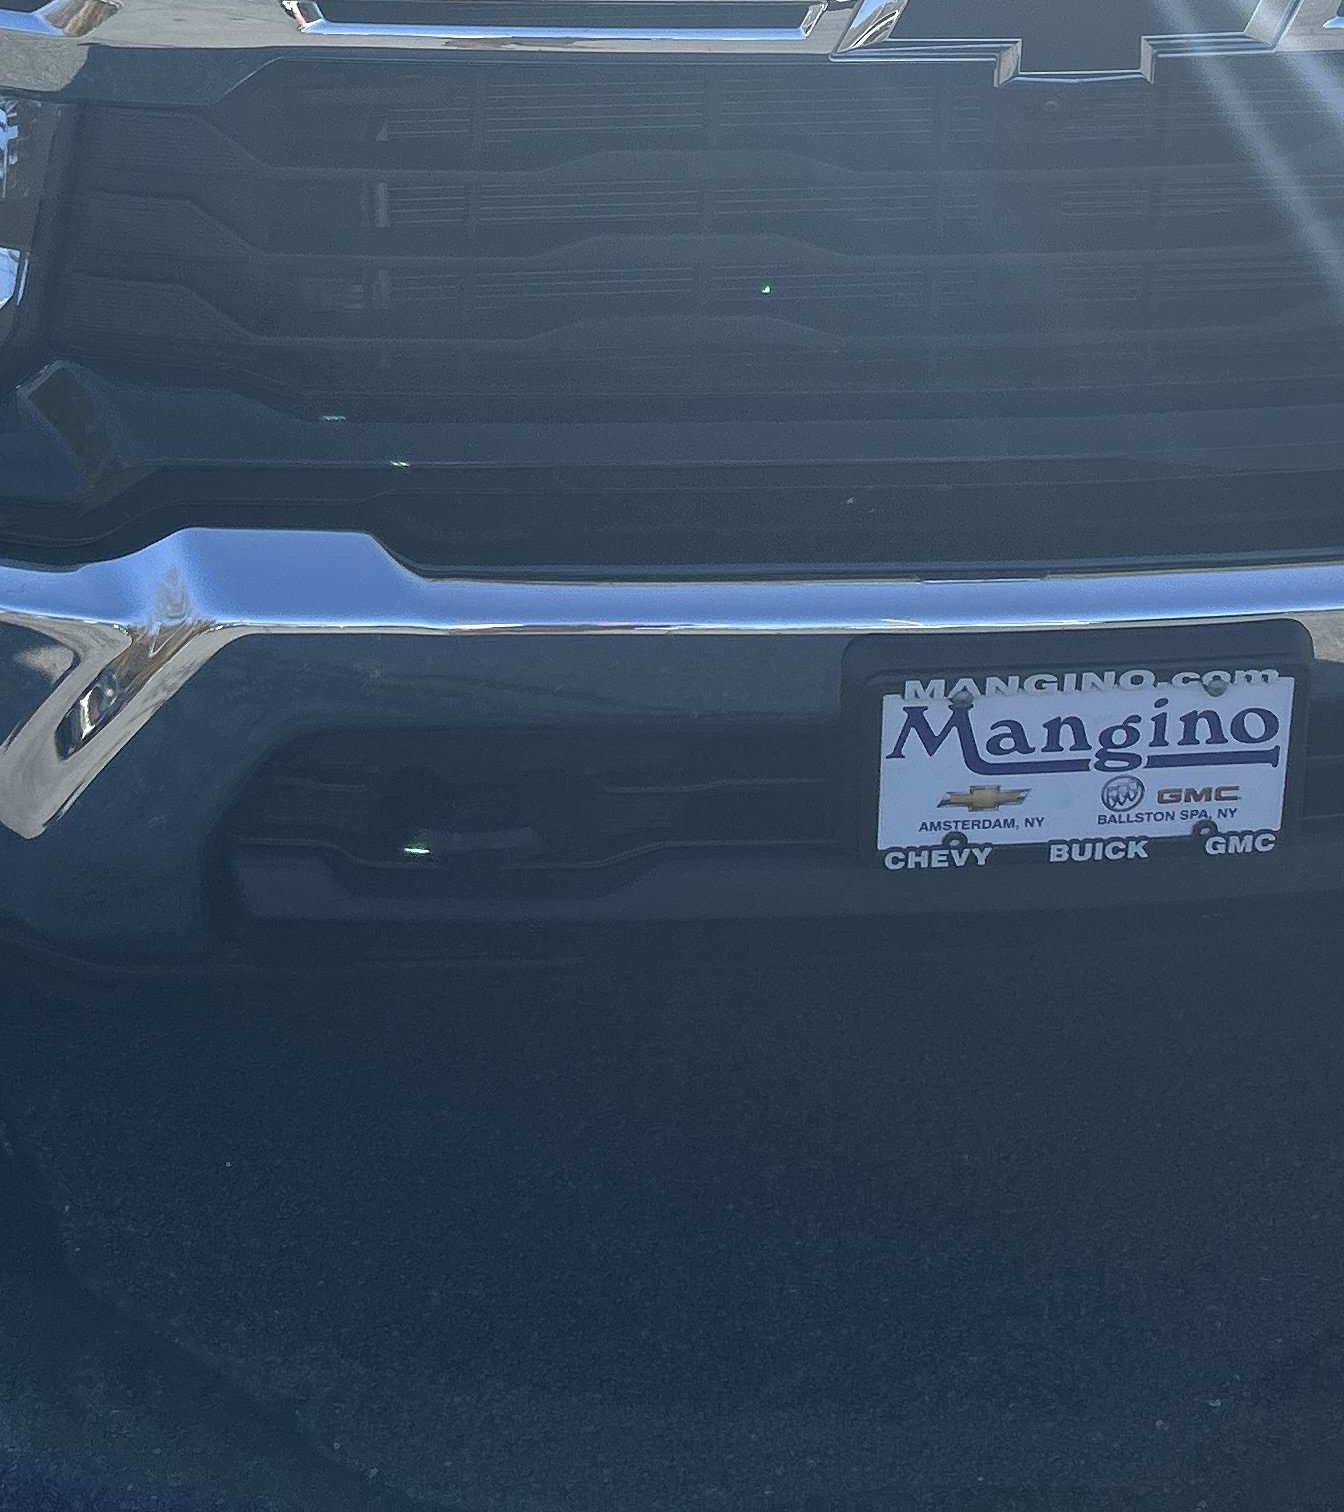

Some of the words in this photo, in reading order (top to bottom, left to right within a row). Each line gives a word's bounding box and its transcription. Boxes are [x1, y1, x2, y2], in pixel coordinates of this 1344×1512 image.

[904, 669, 1279, 700] MANGINO.com
[885, 698, 1280, 776] Mangino
[1157, 786, 1242, 804] GMC
[918, 818, 1020, 833] AMSTERDAM,
[1024, 816, 1046, 829] NY
[1097, 810, 1176, 825] BALLSTON
[1180, 809, 1212, 821] SPA,
[1217, 807, 1238, 819] NY
[884, 847, 992, 870] CHEVY
[1049, 840, 1148, 862] BUICK
[1205, 834, 1276, 855] GMC
